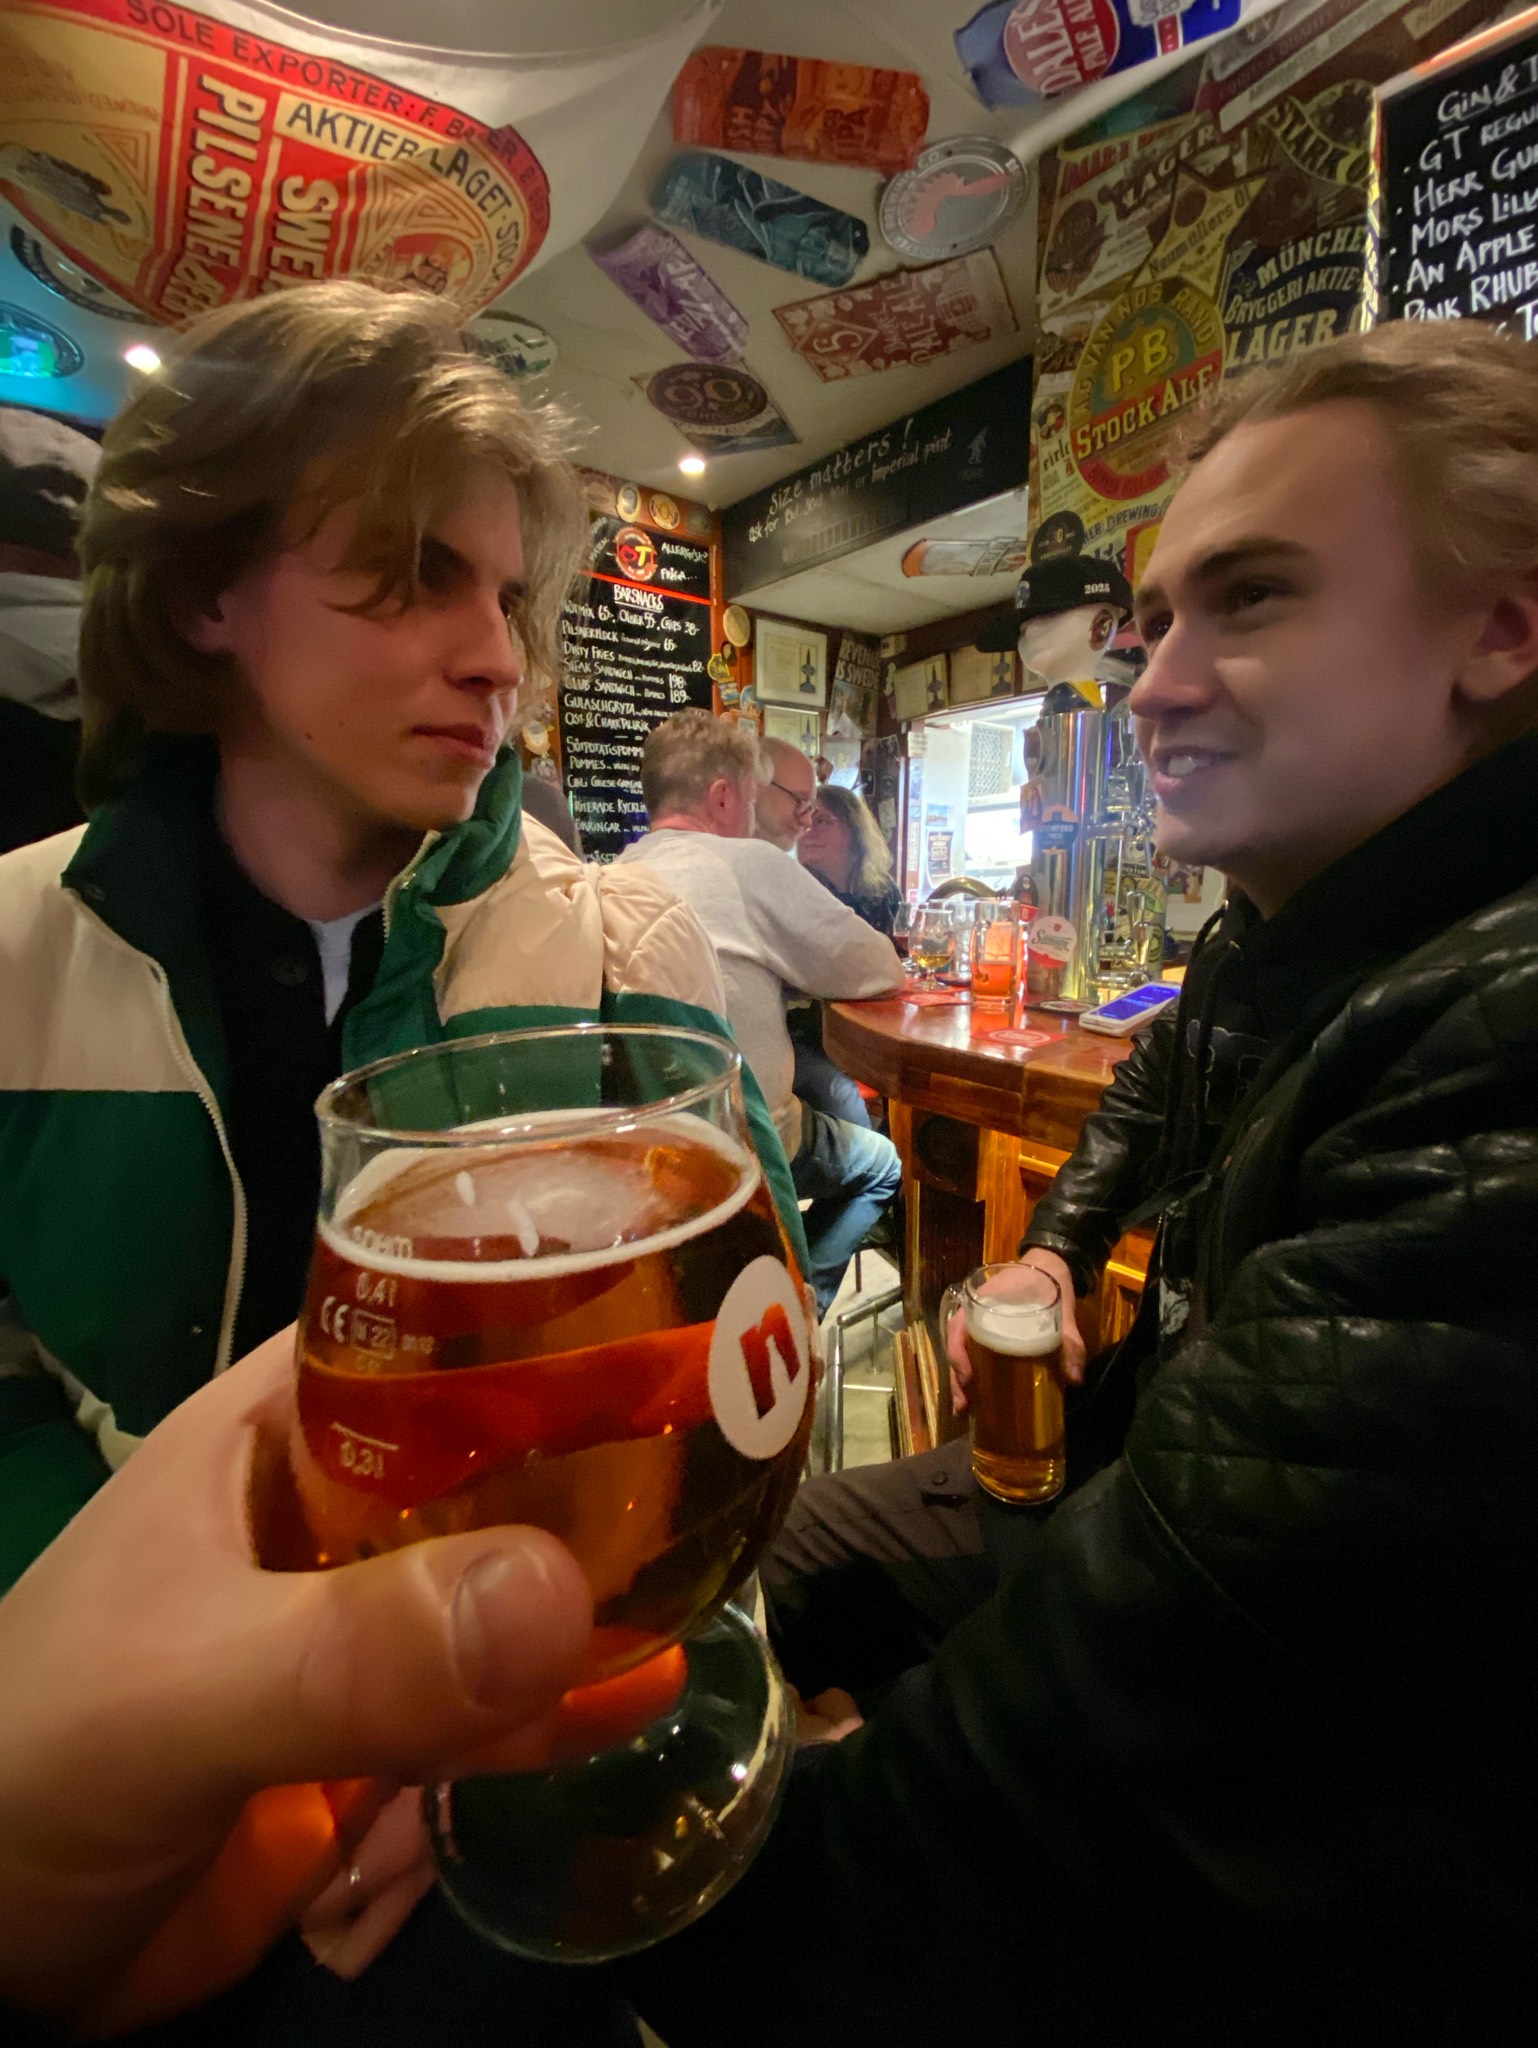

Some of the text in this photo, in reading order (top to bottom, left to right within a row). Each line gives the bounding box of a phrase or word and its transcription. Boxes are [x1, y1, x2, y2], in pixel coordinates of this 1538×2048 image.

[126, 0, 214, 50] SOLE
[1122, 125, 1217, 208] LAGER
[1413, 170, 1484, 217] HERR
[1411, 206, 1485, 256] MORS
[1456, 223, 1537, 275] APPLE
[1256, 225, 1367, 290] MÜNCHE
[1224, 275, 1304, 325] BRYGGERI
[1225, 308, 1338, 367] LAGER
[1076, 363, 1214, 460] STOCK ALE
[809, 432, 891, 491] matters
[613, 583, 665, 611] BARSNACKS
[563, 692, 636, 717] GULASCHGRYTA
[569, 755, 606, 770] POMMES
